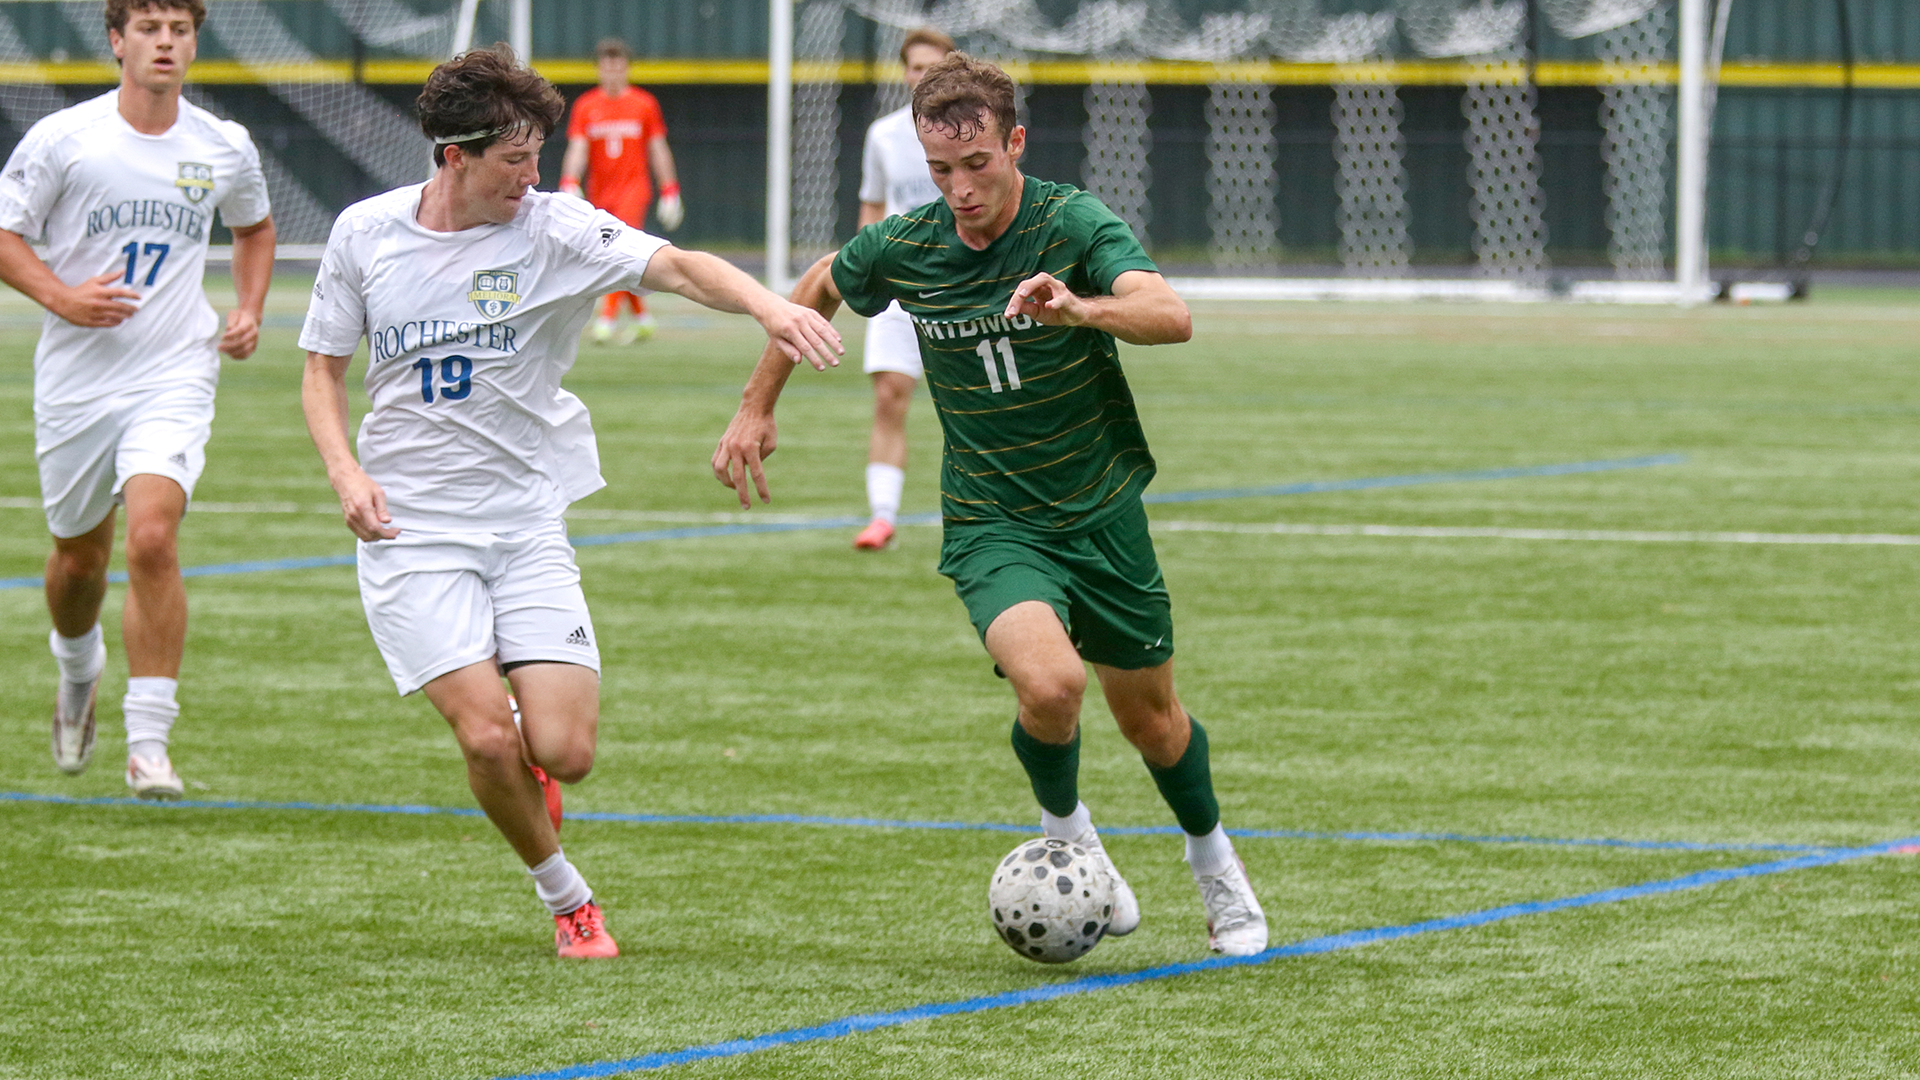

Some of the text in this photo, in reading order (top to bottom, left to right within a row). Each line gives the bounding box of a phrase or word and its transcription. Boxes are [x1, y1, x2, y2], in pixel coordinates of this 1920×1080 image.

[86, 200, 205, 242] ROCHESTER
[122, 241, 170, 287] 17
[474, 291, 515, 301] MELIORA
[374, 320, 519, 364] ROCHESTER
[412, 355, 473, 404] 19
[976, 336, 1022, 394] 11
